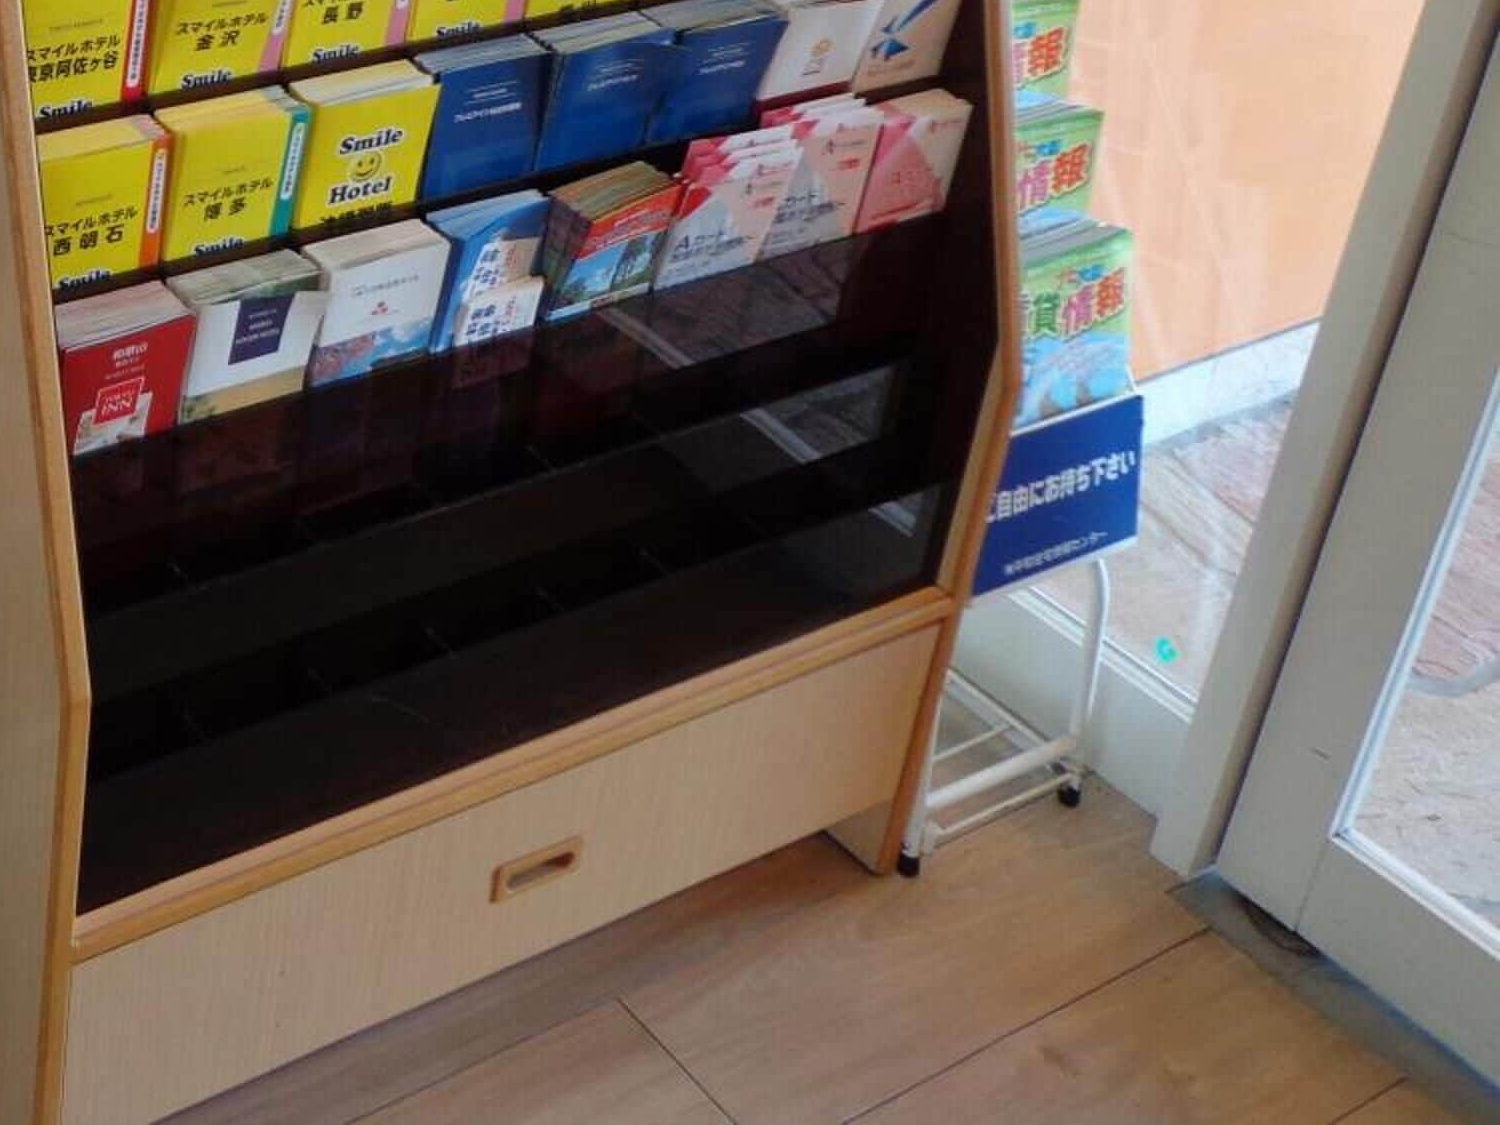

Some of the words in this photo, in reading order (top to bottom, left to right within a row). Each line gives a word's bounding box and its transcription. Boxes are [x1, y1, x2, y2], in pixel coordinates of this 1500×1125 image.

[175, 11, 270, 36] スマイルホテル
[321, 2, 365, 25] 長野
[25, 33, 121, 62] スマイルホテル
[195, 29, 240, 53] 金沢
[312, 43, 360, 63] Smile
[181, 69, 232, 88] Smile
[39, 99, 92, 121] Smile
[339, 127, 403, 154] Smile
[182, 177, 274, 208] スマイルホテル
[328, 177, 392, 206] Hotel
[44, 205, 139, 237] スマイルホテル
[52, 228, 125, 257] 西明石
[194, 236, 244, 256] Smile
[58, 268, 111, 289] Smile
[1020, 267, 1125, 338] 貸情報
